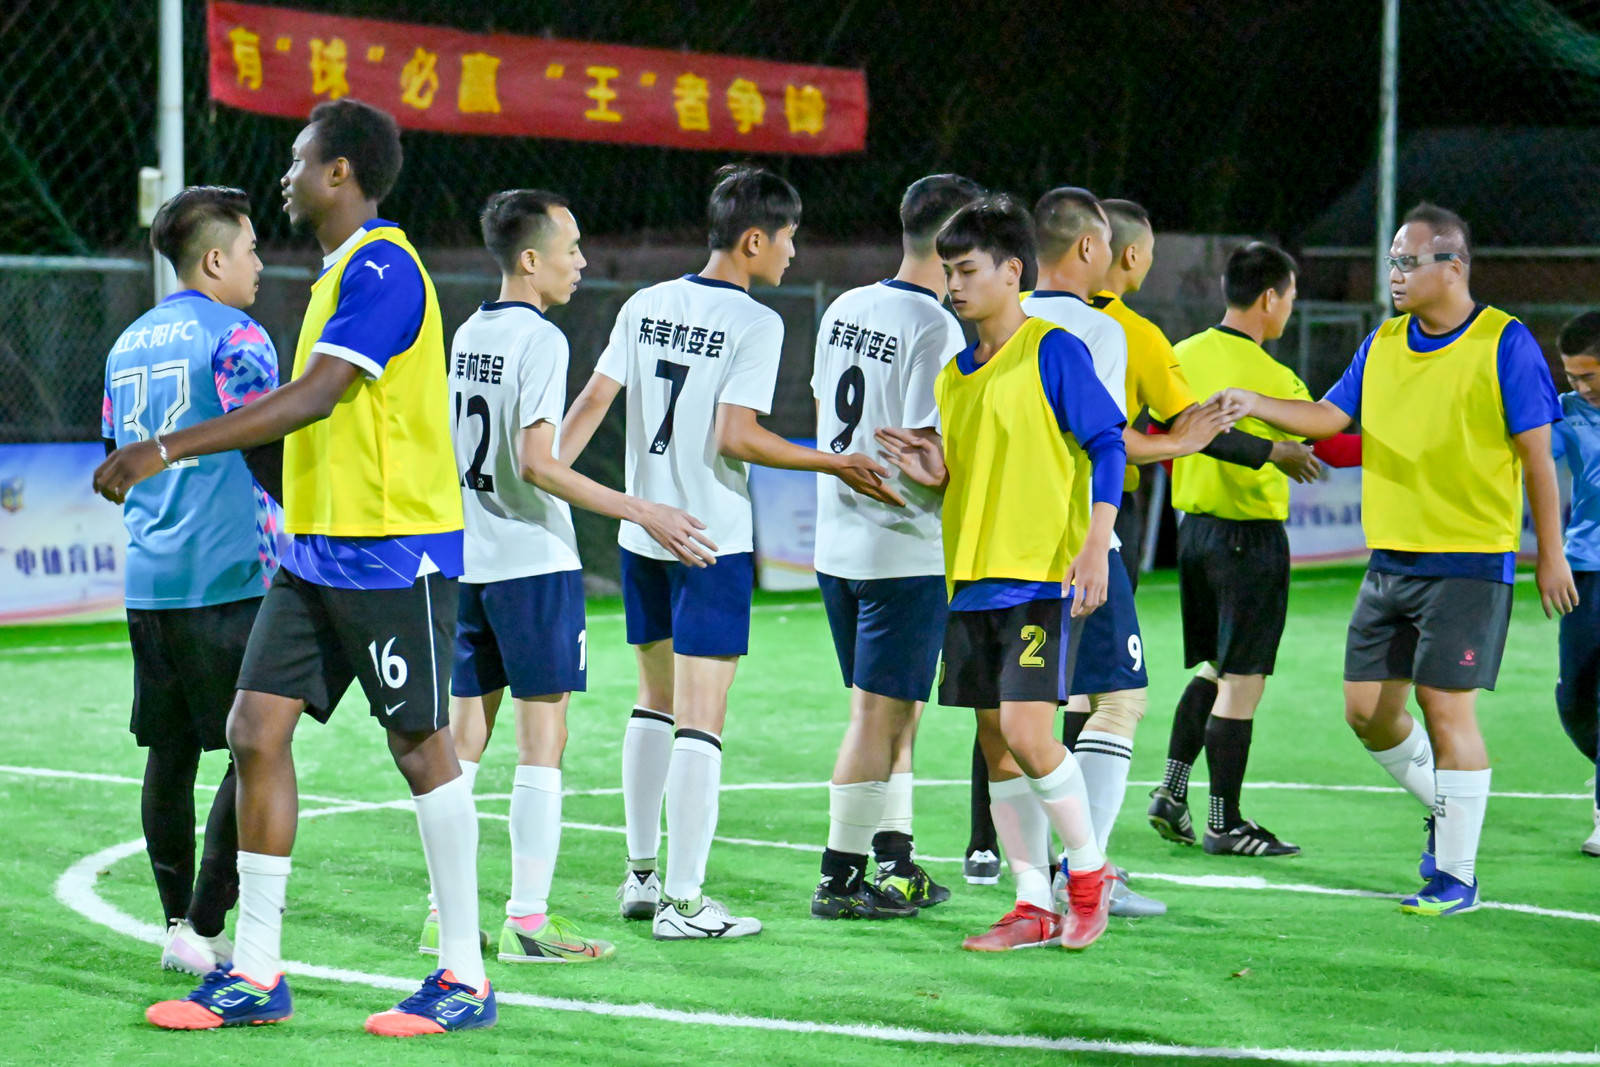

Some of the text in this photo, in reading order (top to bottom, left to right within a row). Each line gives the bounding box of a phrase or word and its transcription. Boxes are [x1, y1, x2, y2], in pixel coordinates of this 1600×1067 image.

[638, 316, 725, 359] 东岸村委会
[828, 318, 898, 364] 东岸村委会
[649, 360, 690, 455] 7
[830, 365, 866, 453] 9
[367, 636, 408, 689] 16
[1018, 624, 1047, 668] 2
[1127, 633, 1143, 672] 9
